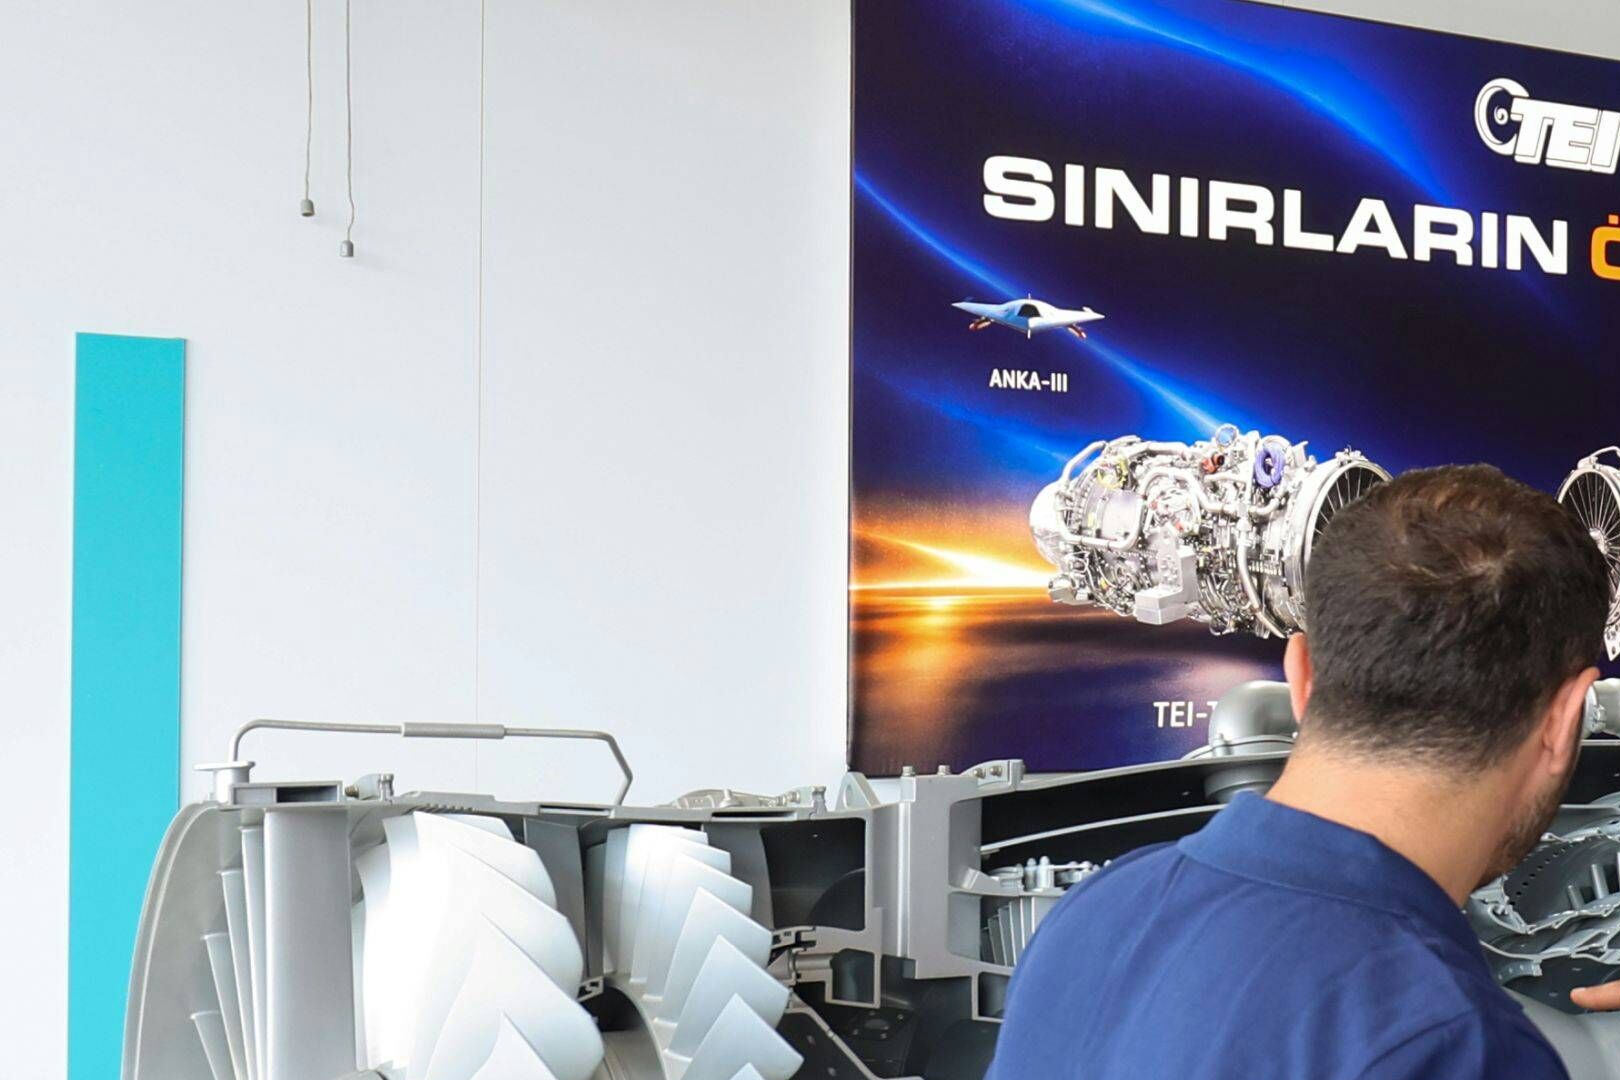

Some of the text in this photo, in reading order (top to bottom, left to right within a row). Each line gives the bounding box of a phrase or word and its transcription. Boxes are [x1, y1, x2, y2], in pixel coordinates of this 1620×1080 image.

[983, 155, 1568, 275] SINIRLARIN
[989, 369, 1068, 393] ANKA-III
[1153, 701, 1218, 728] TEI-
